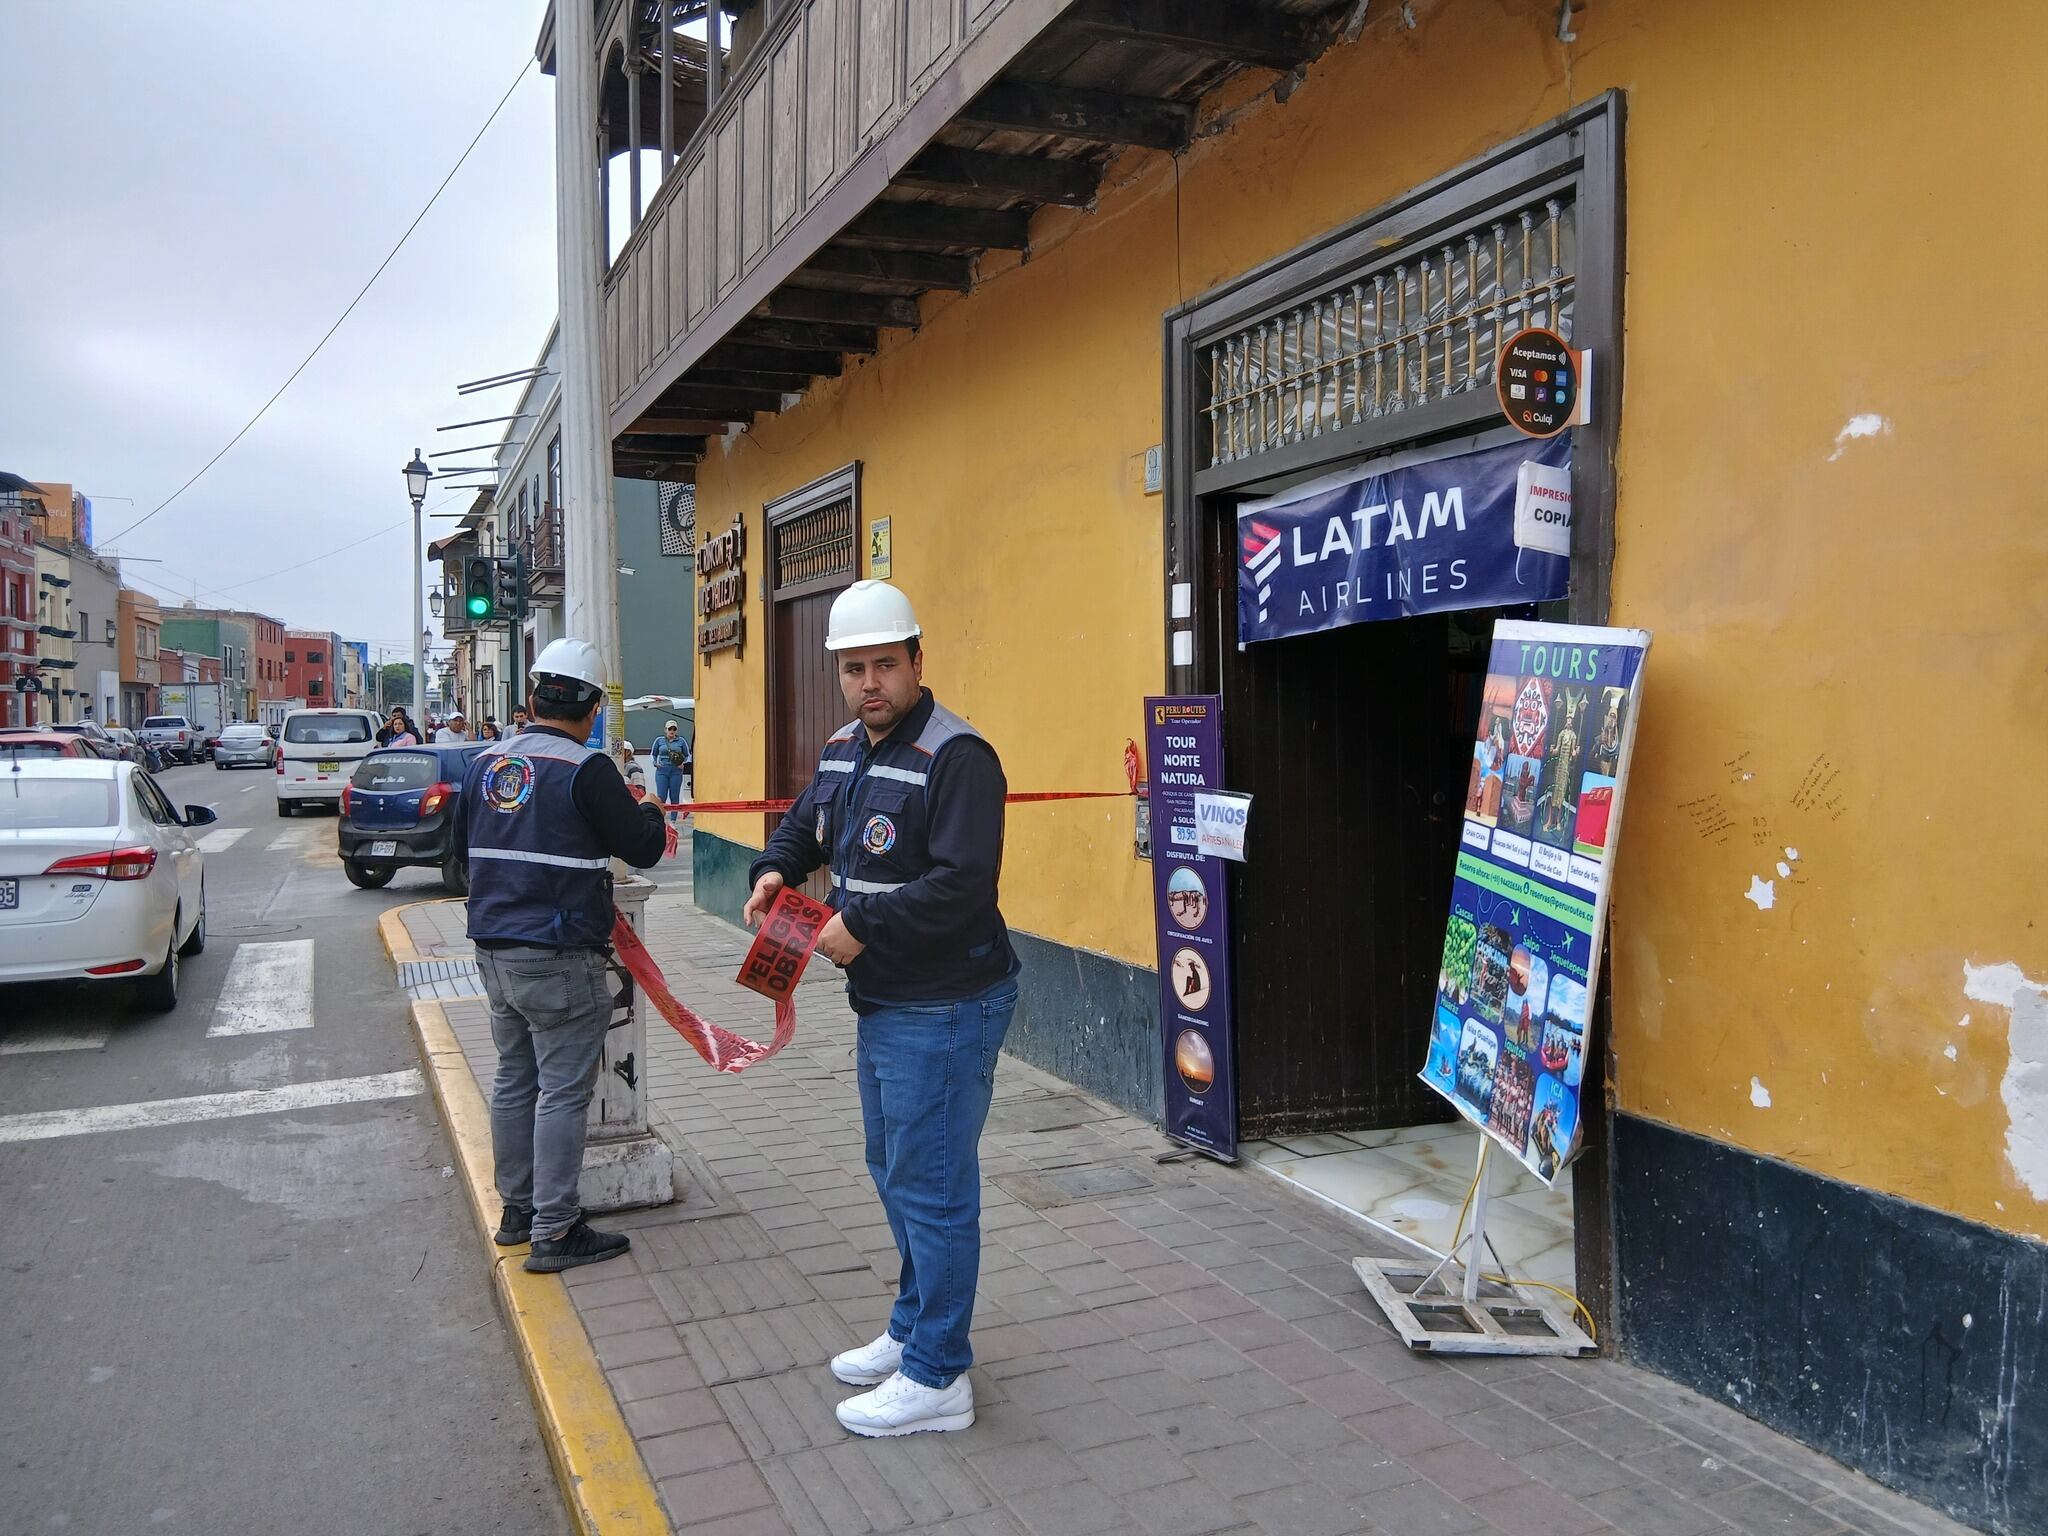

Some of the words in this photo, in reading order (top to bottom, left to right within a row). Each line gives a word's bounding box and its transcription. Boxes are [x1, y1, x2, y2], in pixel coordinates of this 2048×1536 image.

[1512, 346, 1556, 361] Aceptamos
[1509, 368, 1527, 378] VISA
[1533, 412, 1553, 426] Culqi
[1292, 487, 1466, 567] LATAM
[1300, 560, 1467, 616] AIRLINES
[1520, 644, 1599, 681] TOURS
[1166, 705, 1181, 714] PERU
[1166, 736, 1196, 748] TOUR
[1164, 754, 1200, 767] NORTE
[1161, 772, 1205, 786] NATURA
[1200, 804, 1245, 826] VINOS
[1166, 851, 1194, 860] DISFRUTA
[1584, 870, 1590, 879] de
[745, 894, 804, 982] PELIGRO
[1522, 934, 1539, 953] Salpo
[768, 906, 823, 991] OBRAS
[1551, 1081, 1563, 1100] ICA
